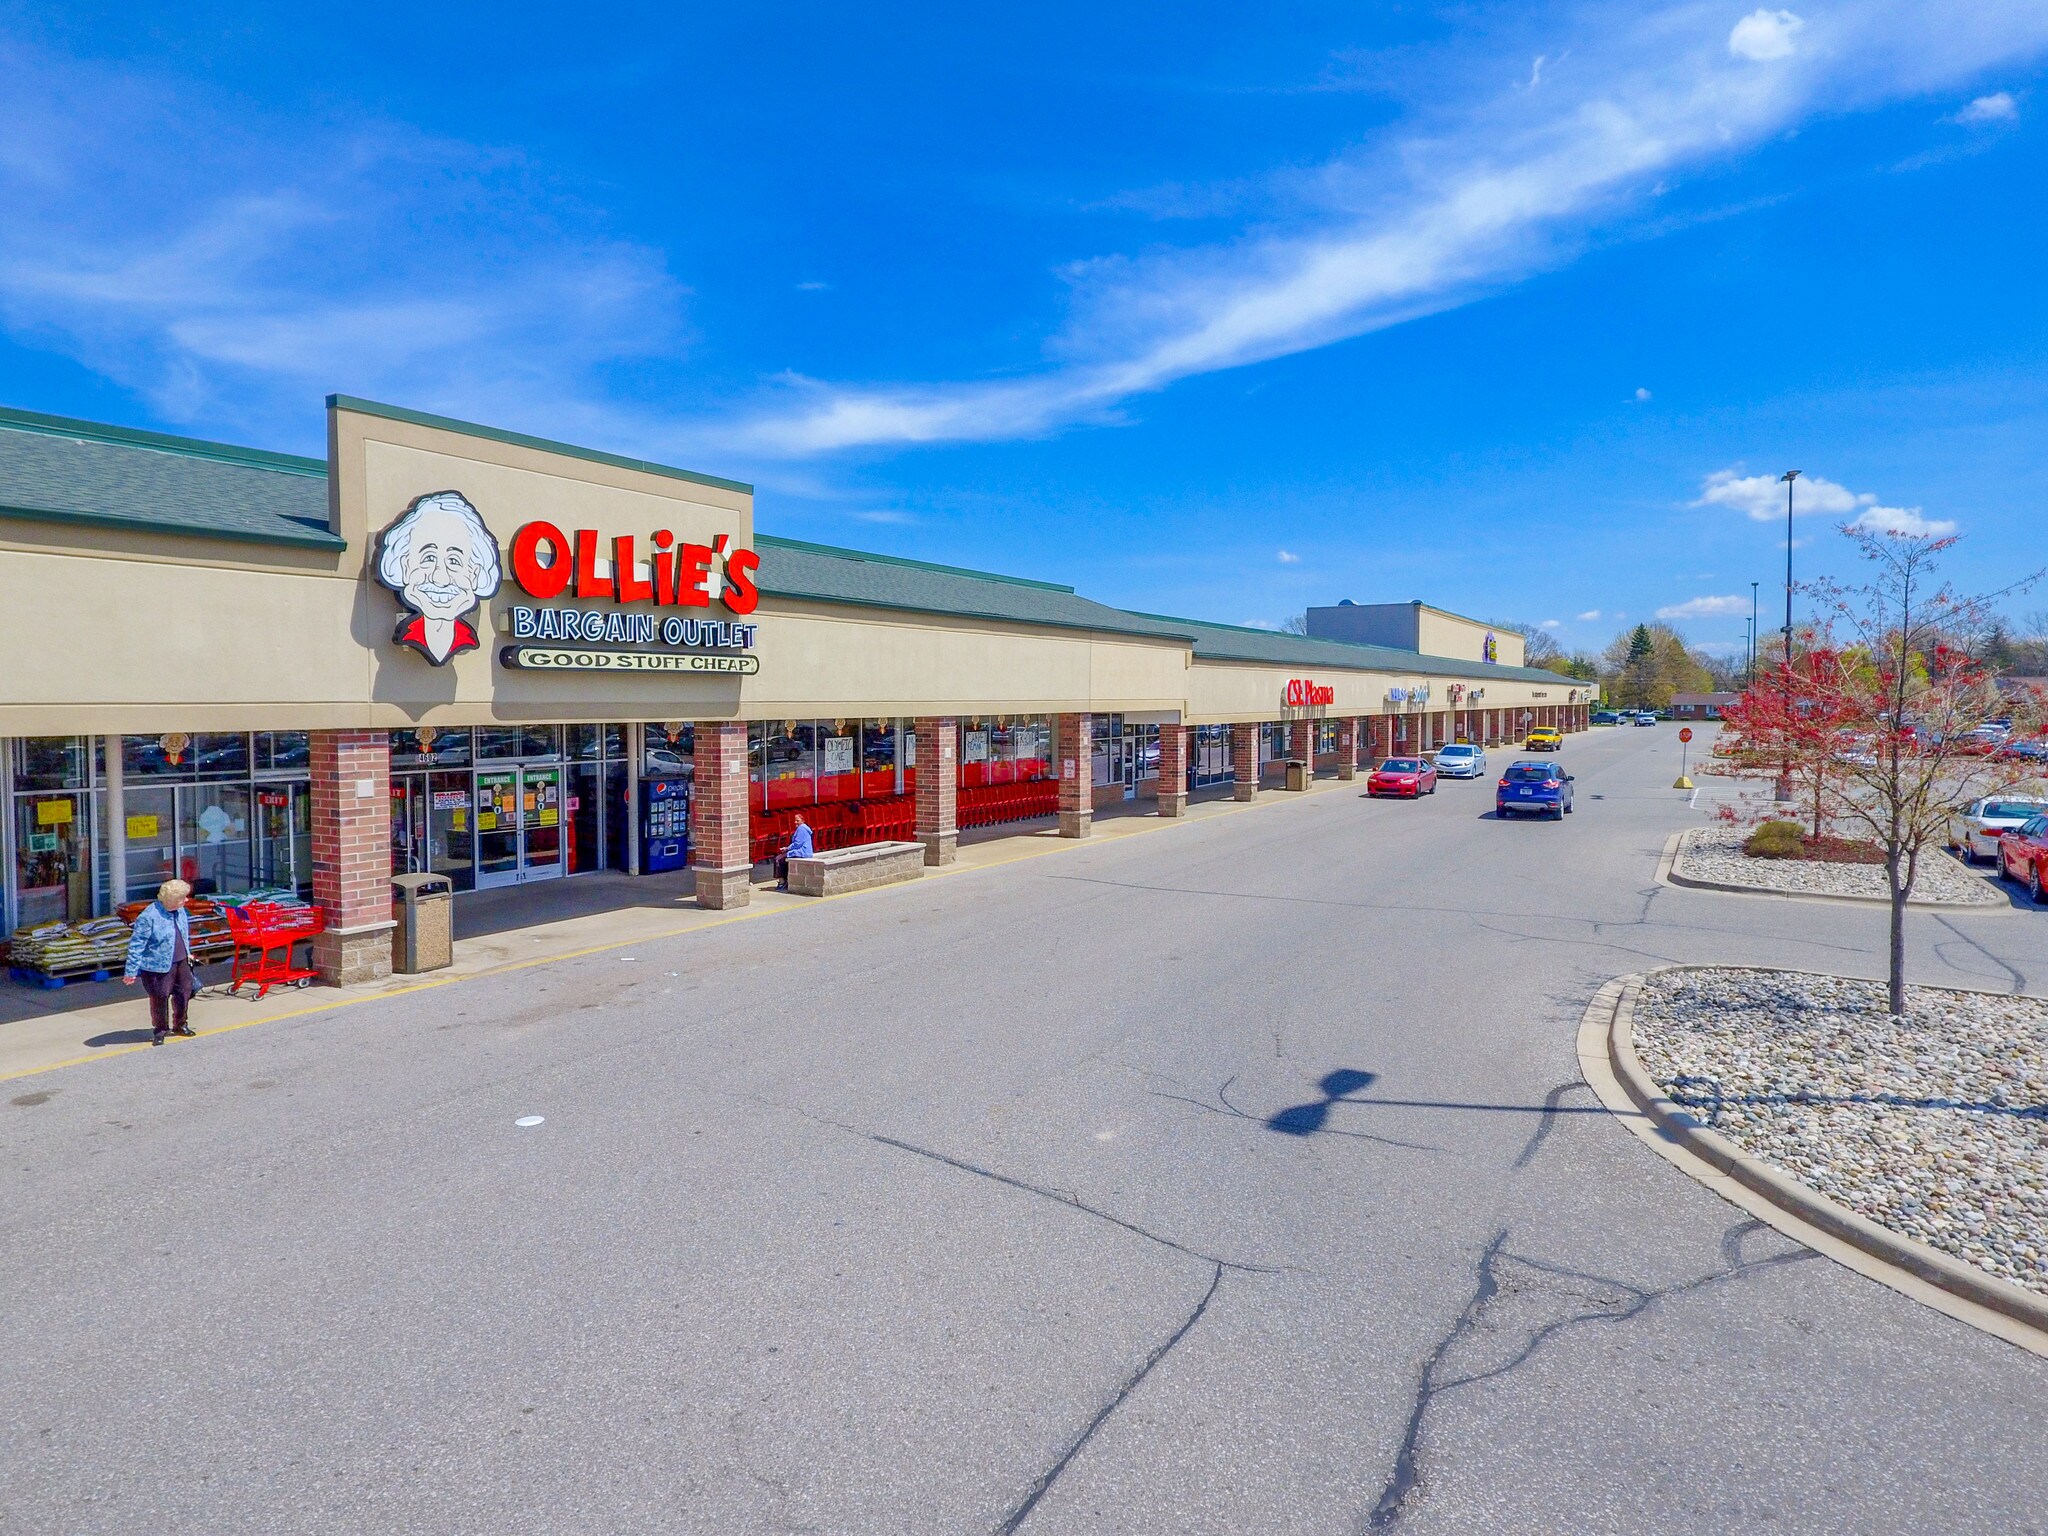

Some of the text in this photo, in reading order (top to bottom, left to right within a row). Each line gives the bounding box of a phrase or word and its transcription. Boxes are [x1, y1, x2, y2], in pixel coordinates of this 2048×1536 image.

[510, 606, 759, 649] BARGAIN OUTLET
[616, 654, 686, 670] STUFF
[1304, 680, 1334, 705] Plasma
[826, 738, 853, 752] OLYMPIC
[419, 753, 437, 762] 4602
[484, 775, 511, 784] ENTRANCE
[527, 773, 553, 782] ENTRANCE
[264, 795, 284, 805] EXIT
